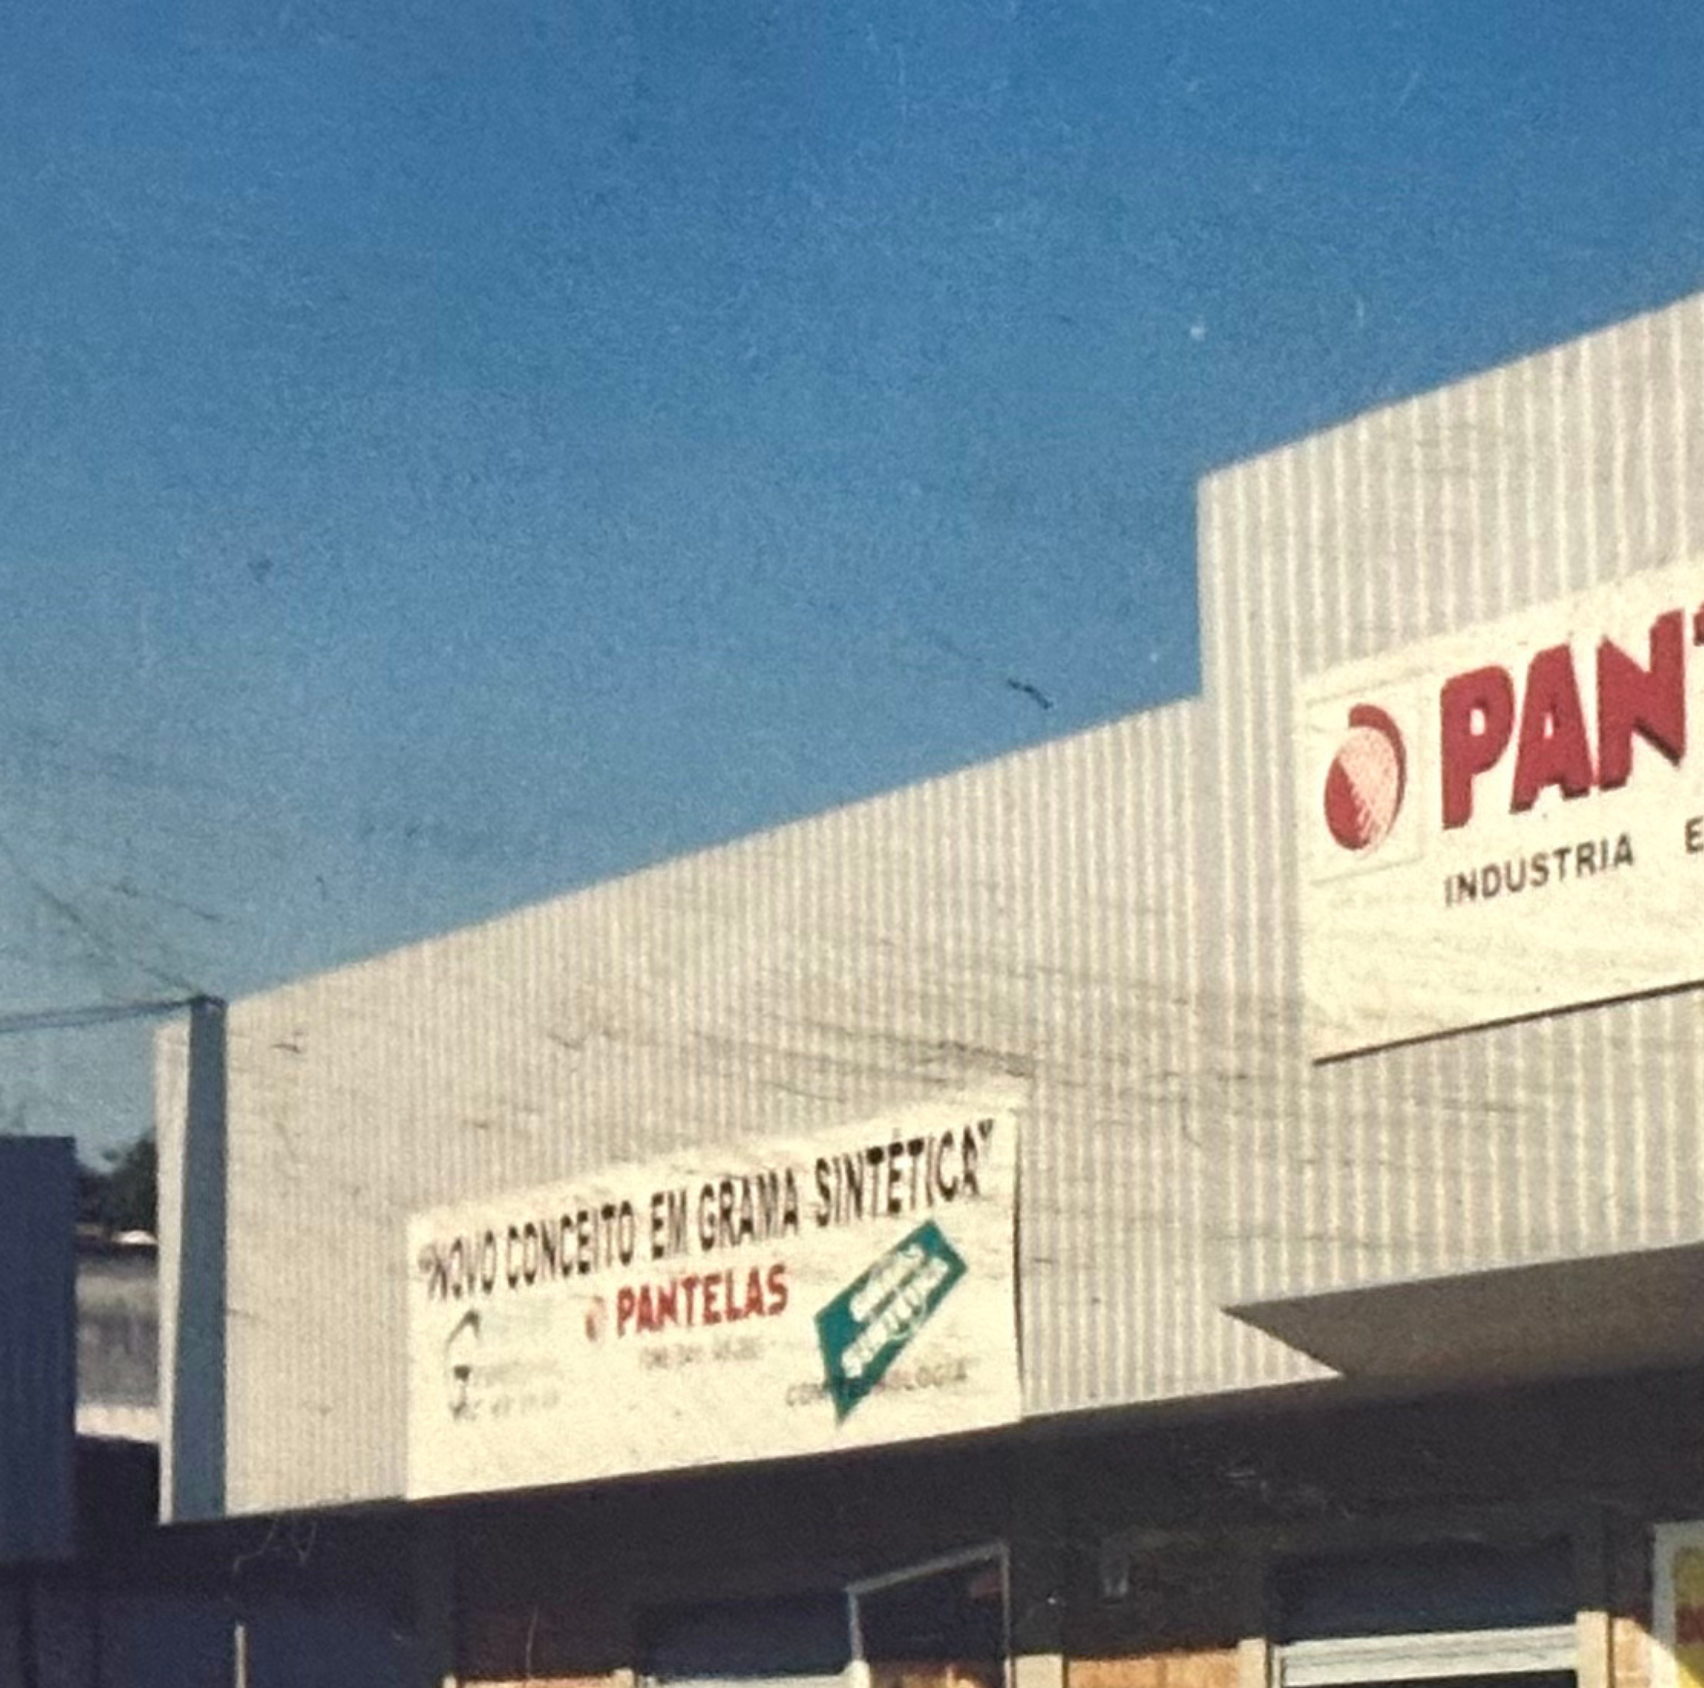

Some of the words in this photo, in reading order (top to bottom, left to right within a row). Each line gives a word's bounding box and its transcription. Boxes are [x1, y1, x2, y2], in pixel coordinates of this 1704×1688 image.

[1444, 833, 1636, 907] INDUSTRIA
[506, 1200, 635, 1290] CONCEITO
[651, 1188, 688, 1261] EM
[698, 1167, 799, 1251] GRAMA
[617, 1263, 791, 1340] PANTELAS
